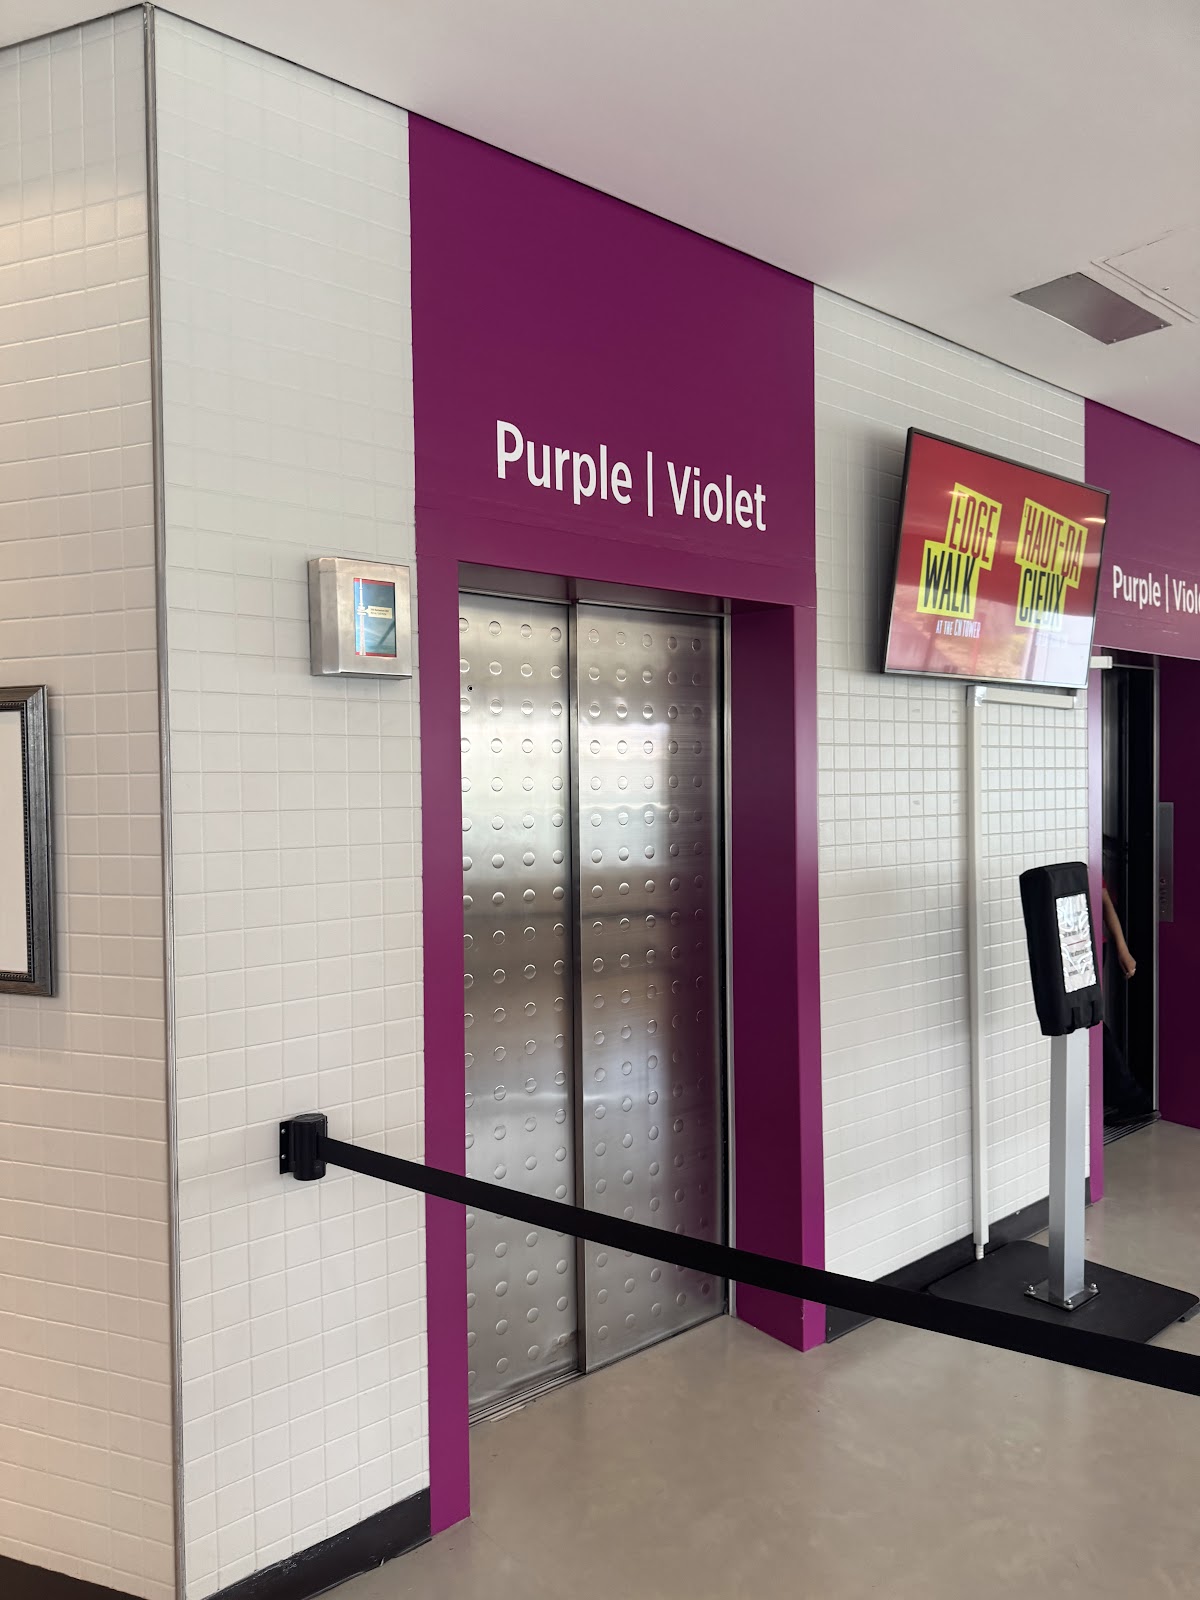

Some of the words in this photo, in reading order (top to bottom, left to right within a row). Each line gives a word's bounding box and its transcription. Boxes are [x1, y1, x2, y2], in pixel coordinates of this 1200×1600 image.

[497, 420, 632, 505] Purple
[667, 461, 767, 531] Violet
[948, 490, 998, 563] EDGE
[924, 548, 976, 613] WALK
[1019, 568, 1065, 628] CIEUX
[1113, 565, 1161, 610] Purple
